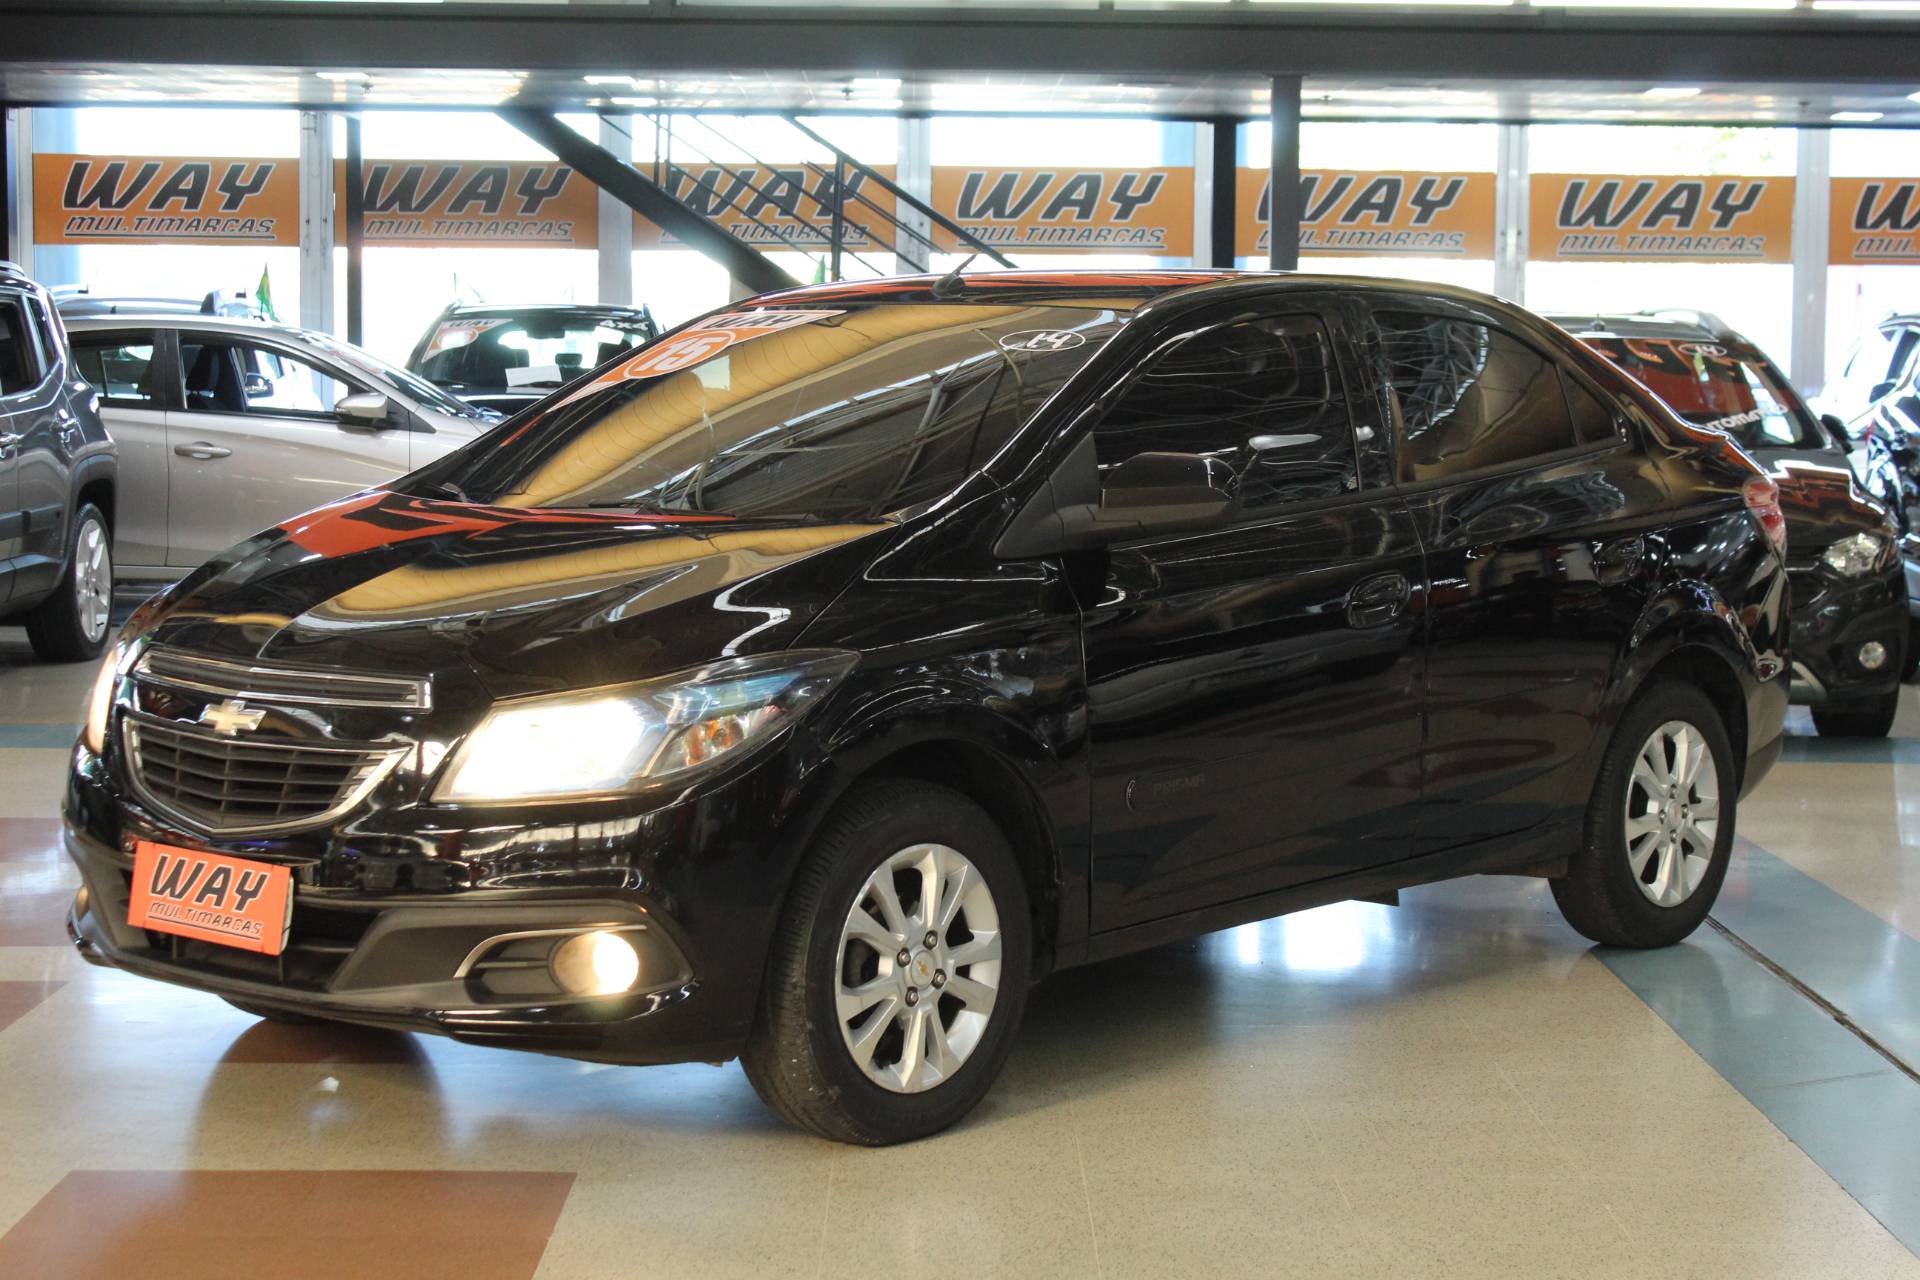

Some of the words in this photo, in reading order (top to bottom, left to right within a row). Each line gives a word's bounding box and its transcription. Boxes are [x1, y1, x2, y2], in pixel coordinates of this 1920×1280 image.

[63, 161, 275, 212] WAY
[363, 165, 573, 215] WAY
[956, 172, 1167, 222] WAY
[1257, 175, 1467, 226] WAY
[1557, 180, 1767, 230] WAY
[65, 215, 275, 233] MULTIMARCAS
[364, 219, 574, 237] MULTIMARCAS
[958, 225, 1167, 244] MULTIMARCAS
[1559, 234, 1766, 252] MULTIMARCAS
[149, 853, 270, 913] WAY
[150, 901, 263, 936] MULTIMARCAS
